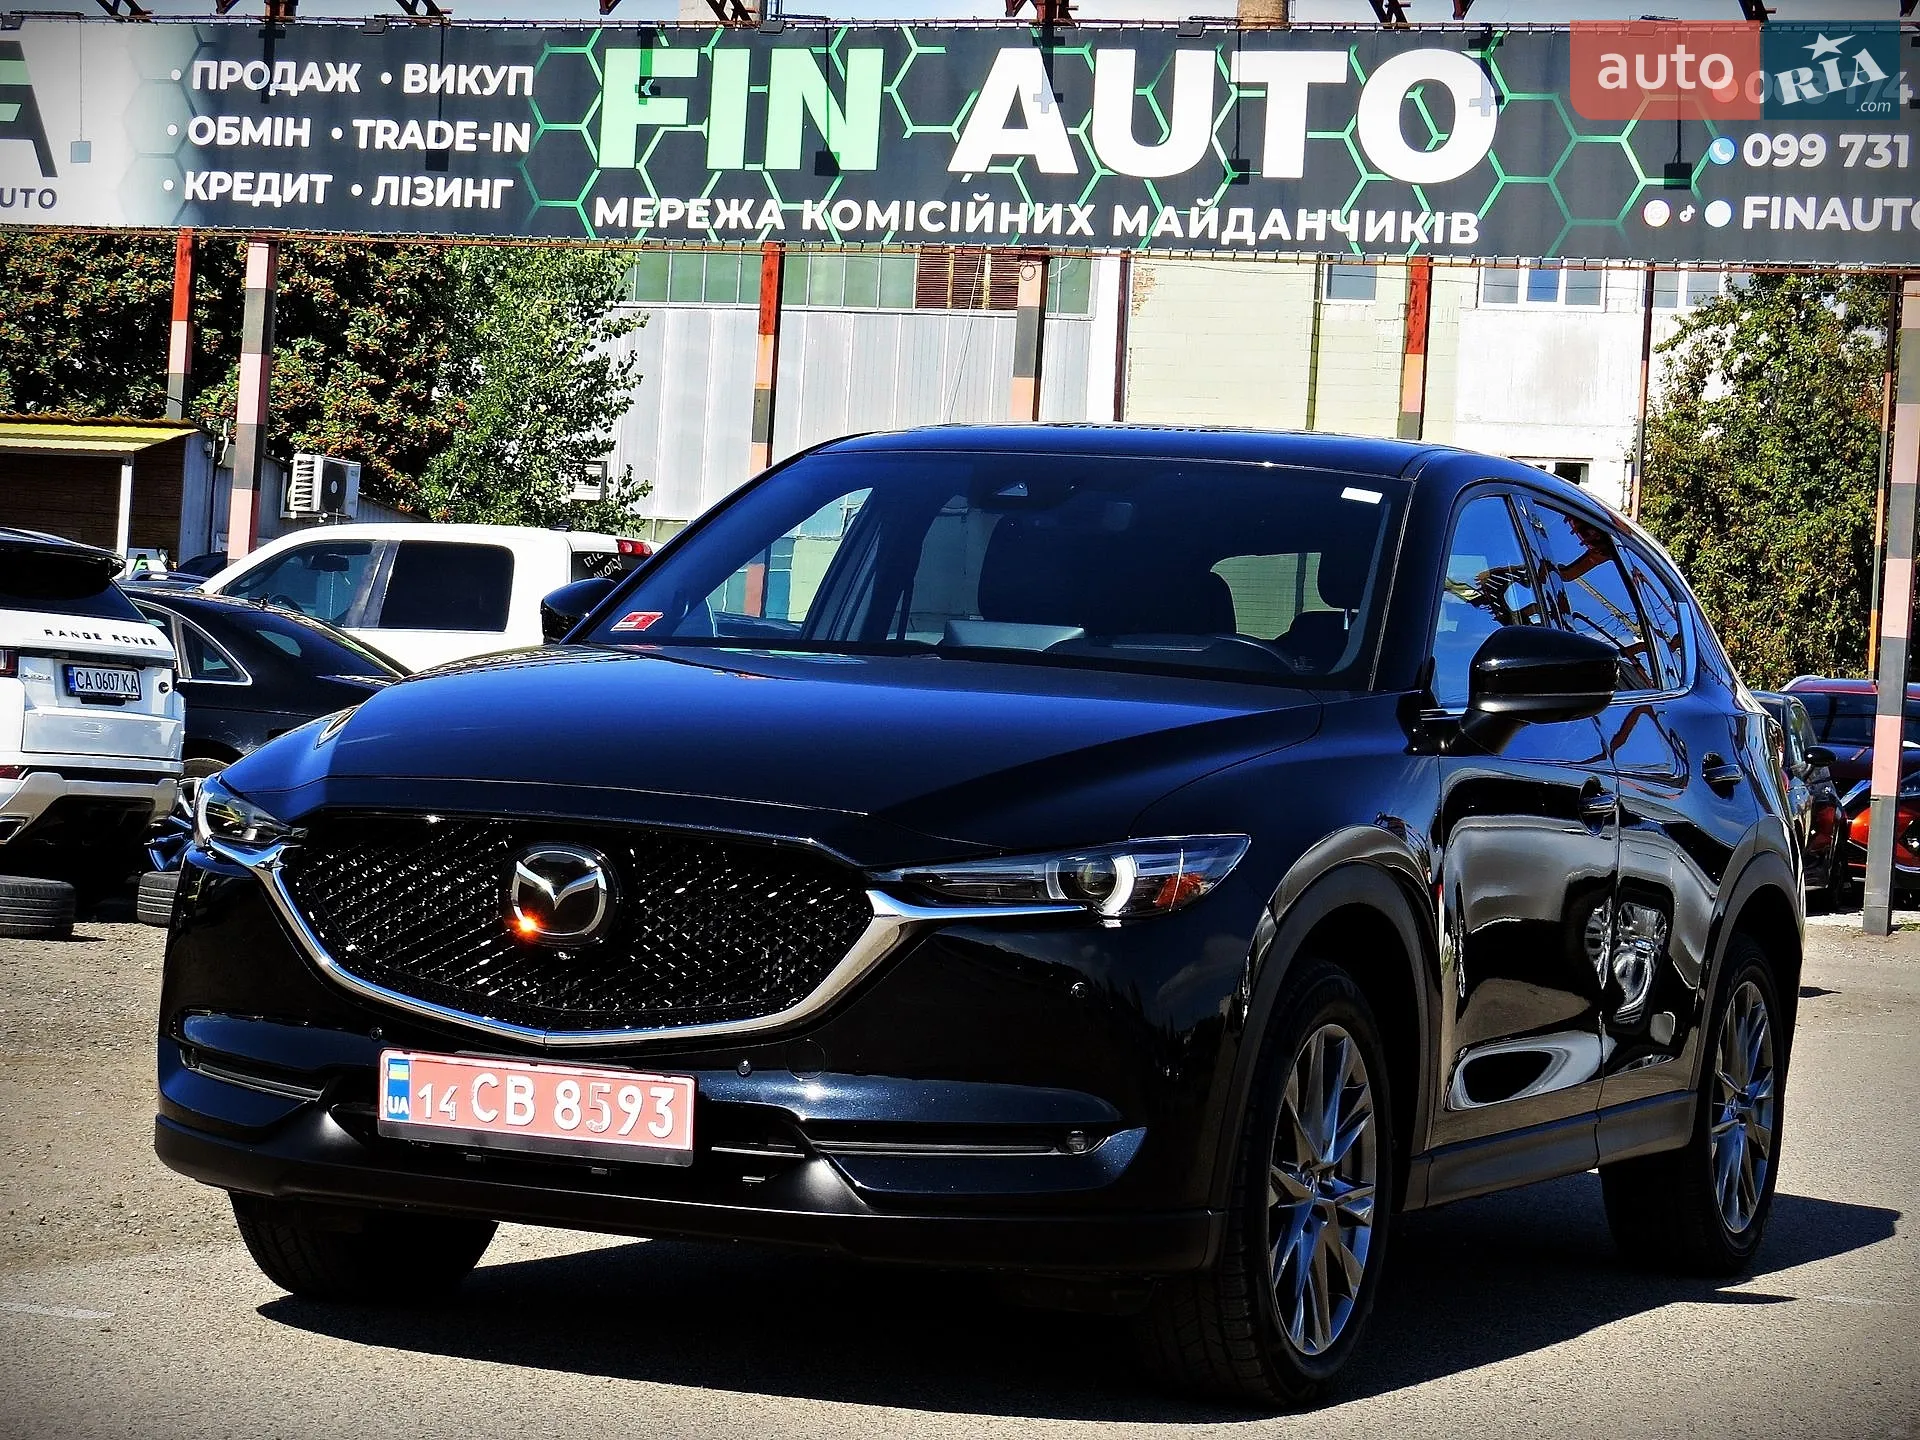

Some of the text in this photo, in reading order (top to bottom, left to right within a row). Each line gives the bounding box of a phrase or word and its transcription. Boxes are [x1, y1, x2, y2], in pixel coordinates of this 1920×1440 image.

[192, 61, 361, 96] ПРОДАЖ
[403, 64, 535, 96] ВИКУП
[187, 116, 311, 148] ОБМІН
[597, 48, 1498, 184] FIN AUTO
[352, 119, 531, 153] TRADE-IN
[1743, 133, 1910, 169] 099 731
[184, 171, 333, 207] КРЕДИТ
[371, 176, 515, 210] ЛІЗИНГ
[594, 192, 1479, 246] МЕРЕЖА КОМІСІЙНИХ МАЙДАНЧИКІВ
[1742, 196, 1920, 231] FINAUT
[44, 629, 157, 646] RANGE ROVER
[76, 671, 138, 692] CA 0607 KA
[388, 1095, 409, 1114] UA
[416, 1073, 675, 1138] 14 CB 8593
